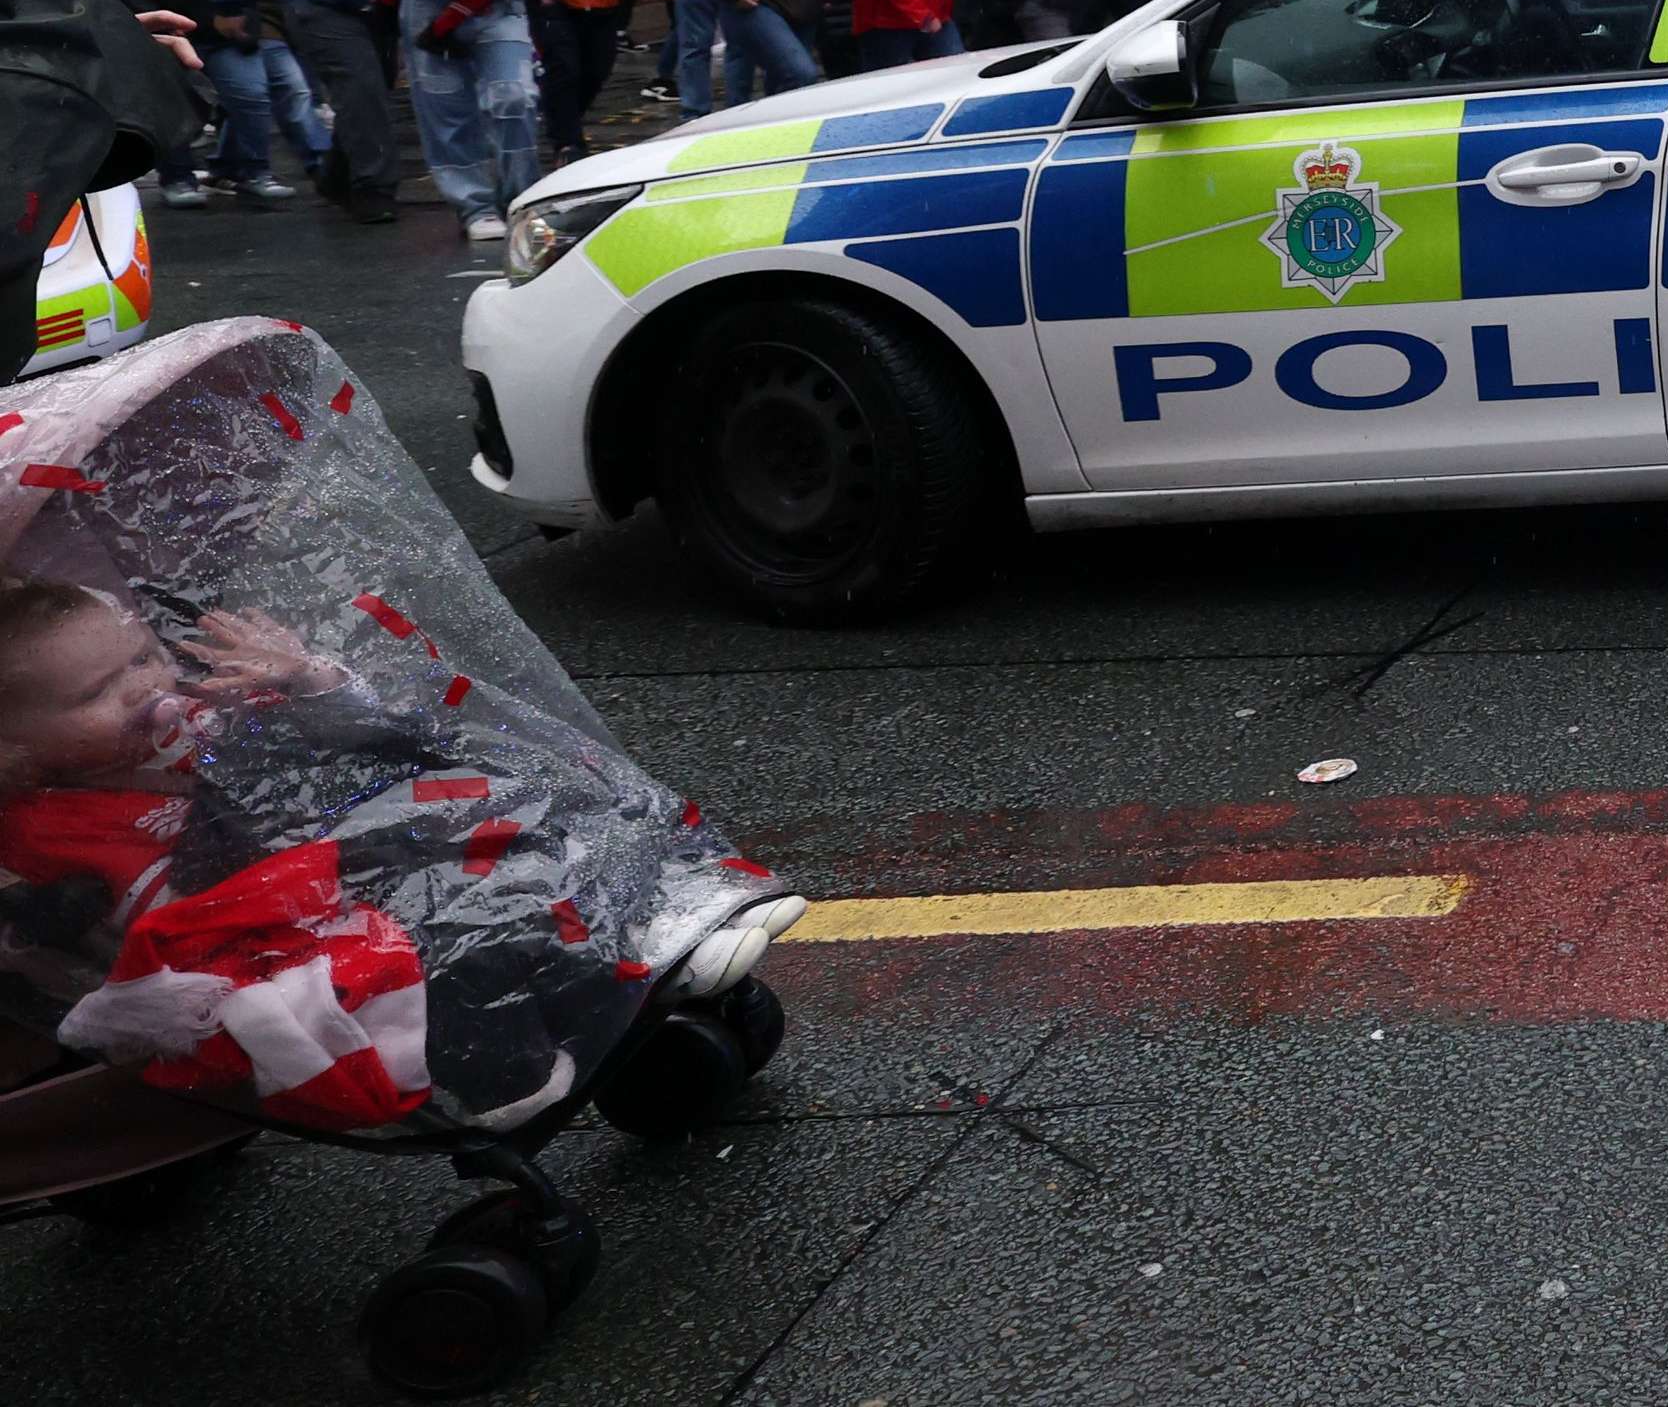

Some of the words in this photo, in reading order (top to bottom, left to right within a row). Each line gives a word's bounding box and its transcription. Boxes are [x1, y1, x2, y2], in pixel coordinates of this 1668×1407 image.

[1293, 194, 1370, 230] MERSEYSIDE
[1308, 217, 1357, 252] ER
[1307, 258, 1359, 275] POLICE
